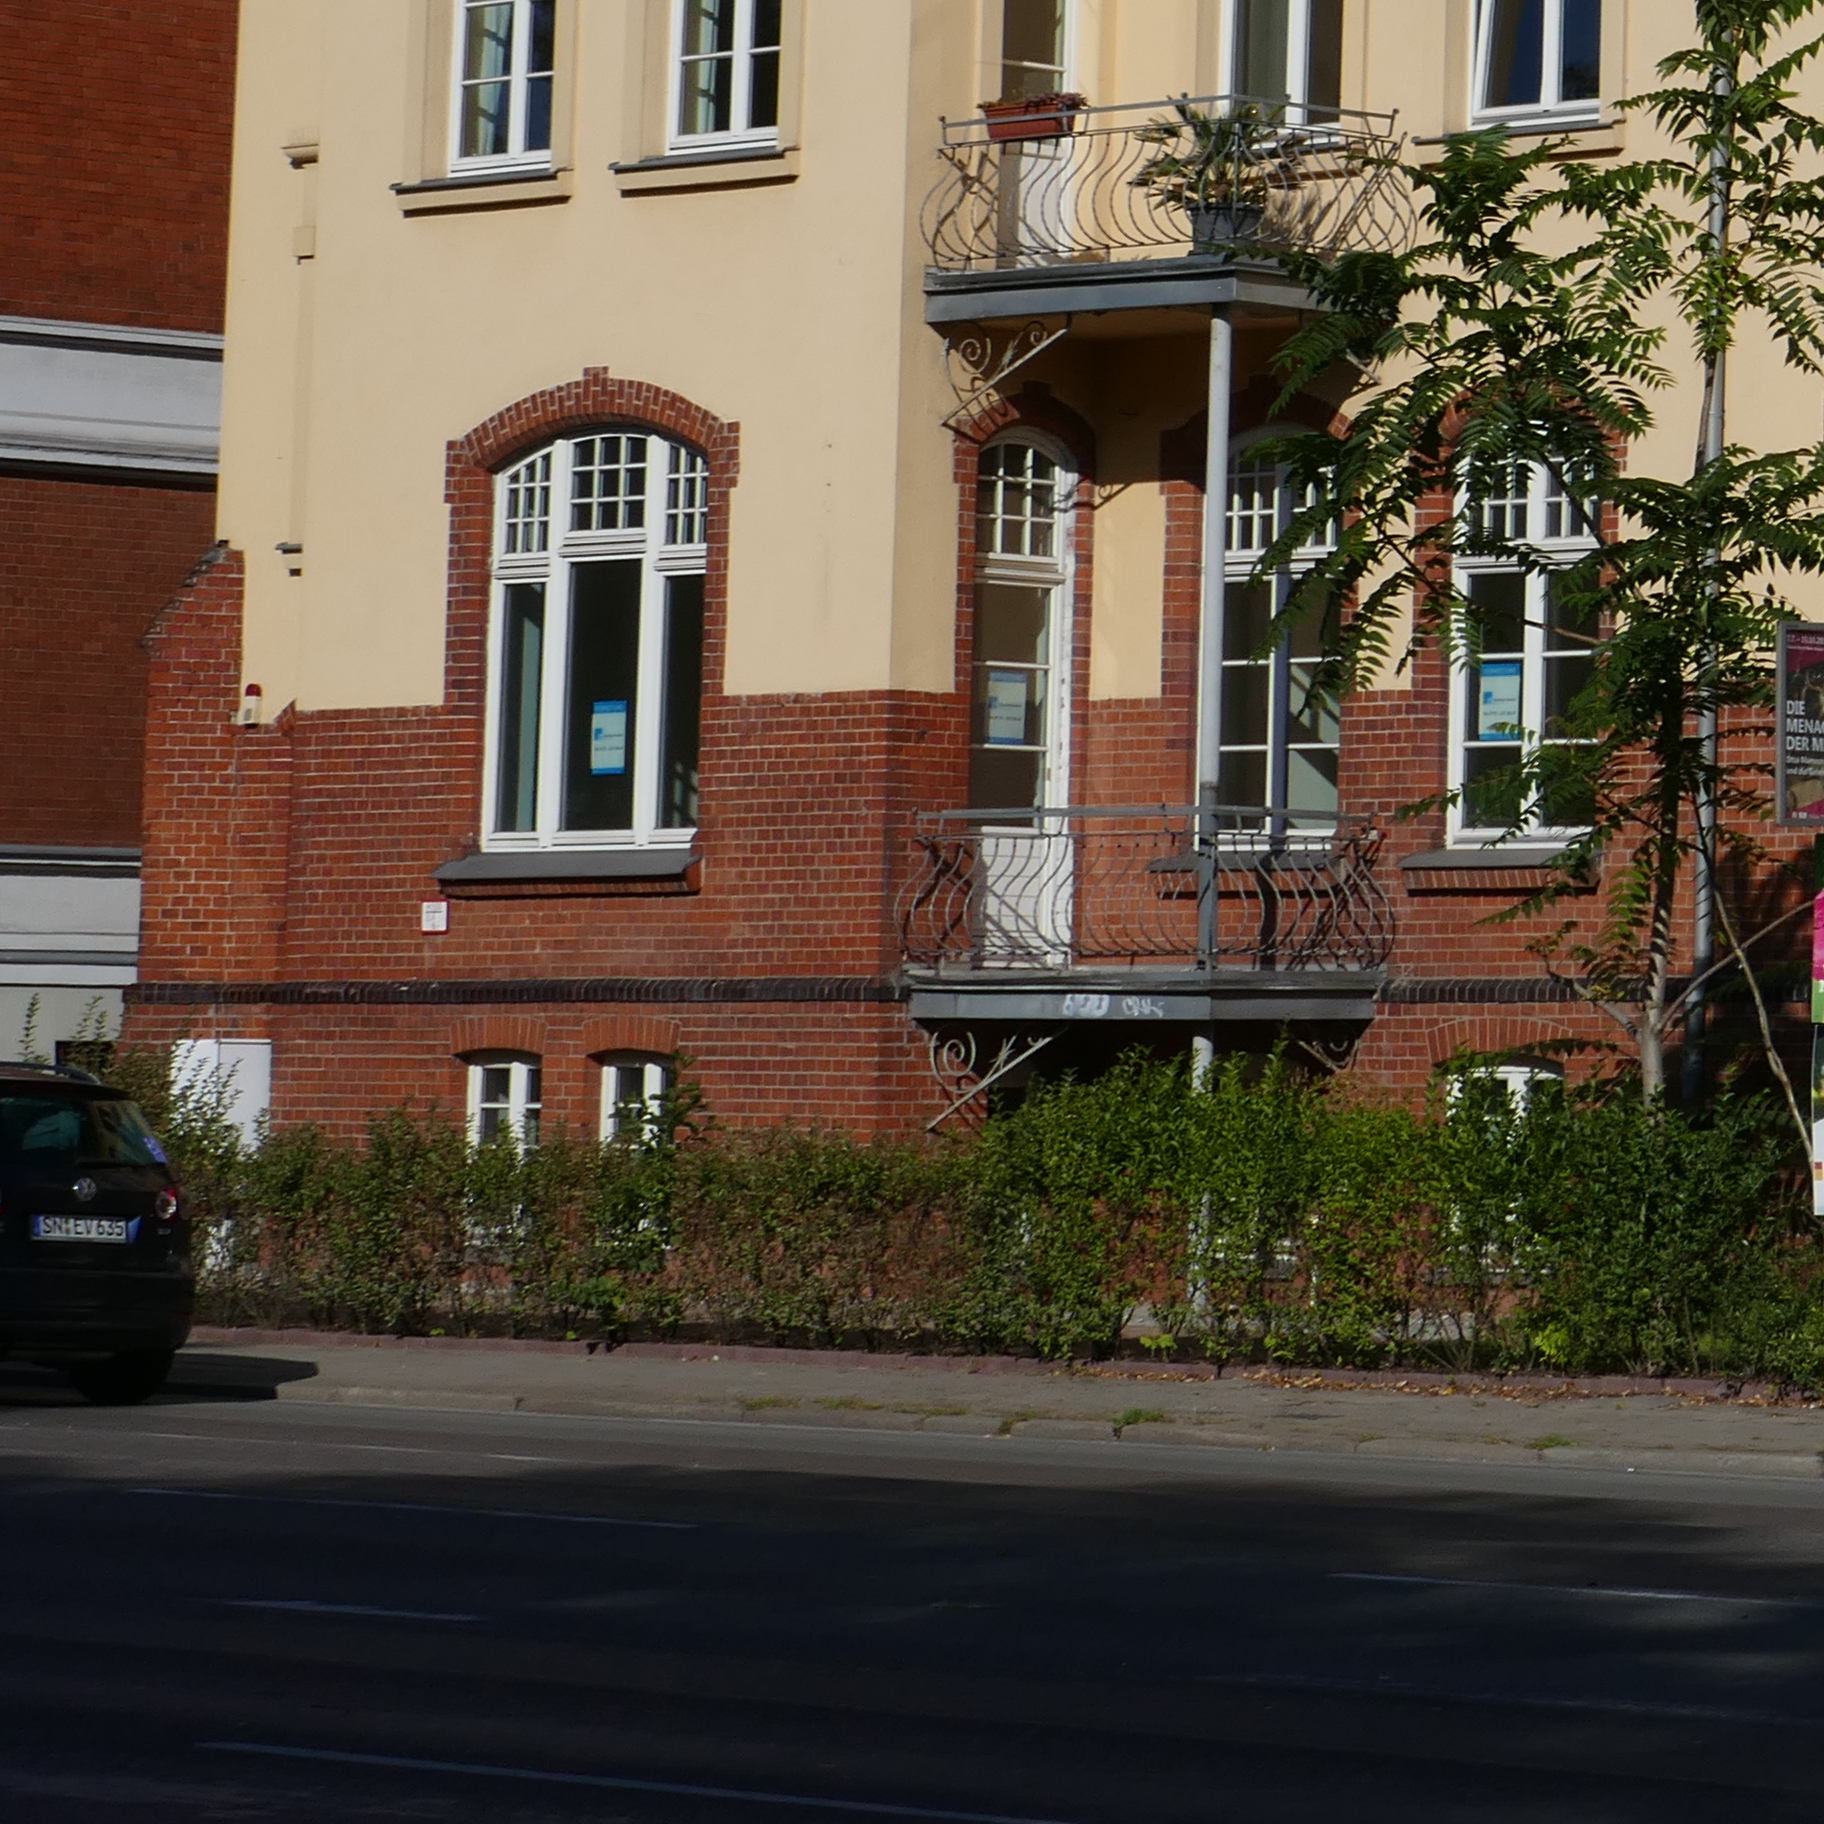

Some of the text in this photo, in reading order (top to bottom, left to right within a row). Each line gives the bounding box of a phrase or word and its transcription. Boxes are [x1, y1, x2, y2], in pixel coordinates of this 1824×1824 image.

[1786, 700, 1806, 715] DIE
[1786, 736, 1809, 751] DER
[97, 1219, 124, 1237] 635
